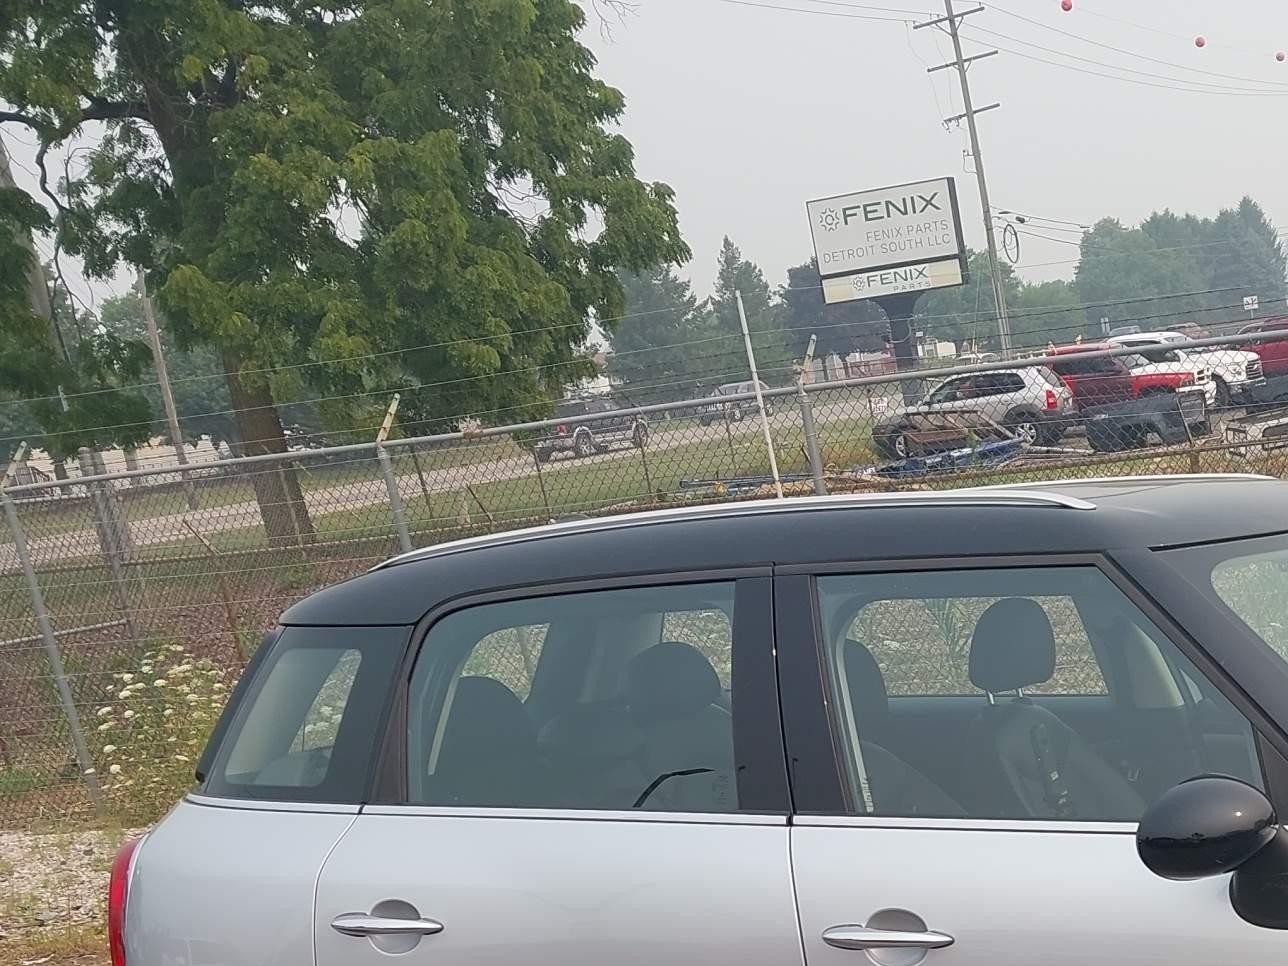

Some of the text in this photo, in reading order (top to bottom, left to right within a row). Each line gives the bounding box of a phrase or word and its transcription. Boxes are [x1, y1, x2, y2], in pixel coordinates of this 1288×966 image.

[841, 192, 942, 226] FENIX
[866, 219, 949, 242] FENIX PARTS
[823, 233, 951, 264] DETROIT SOUTH LLC
[866, 266, 929, 288] FENIX
[893, 281, 931, 292] PARTS
